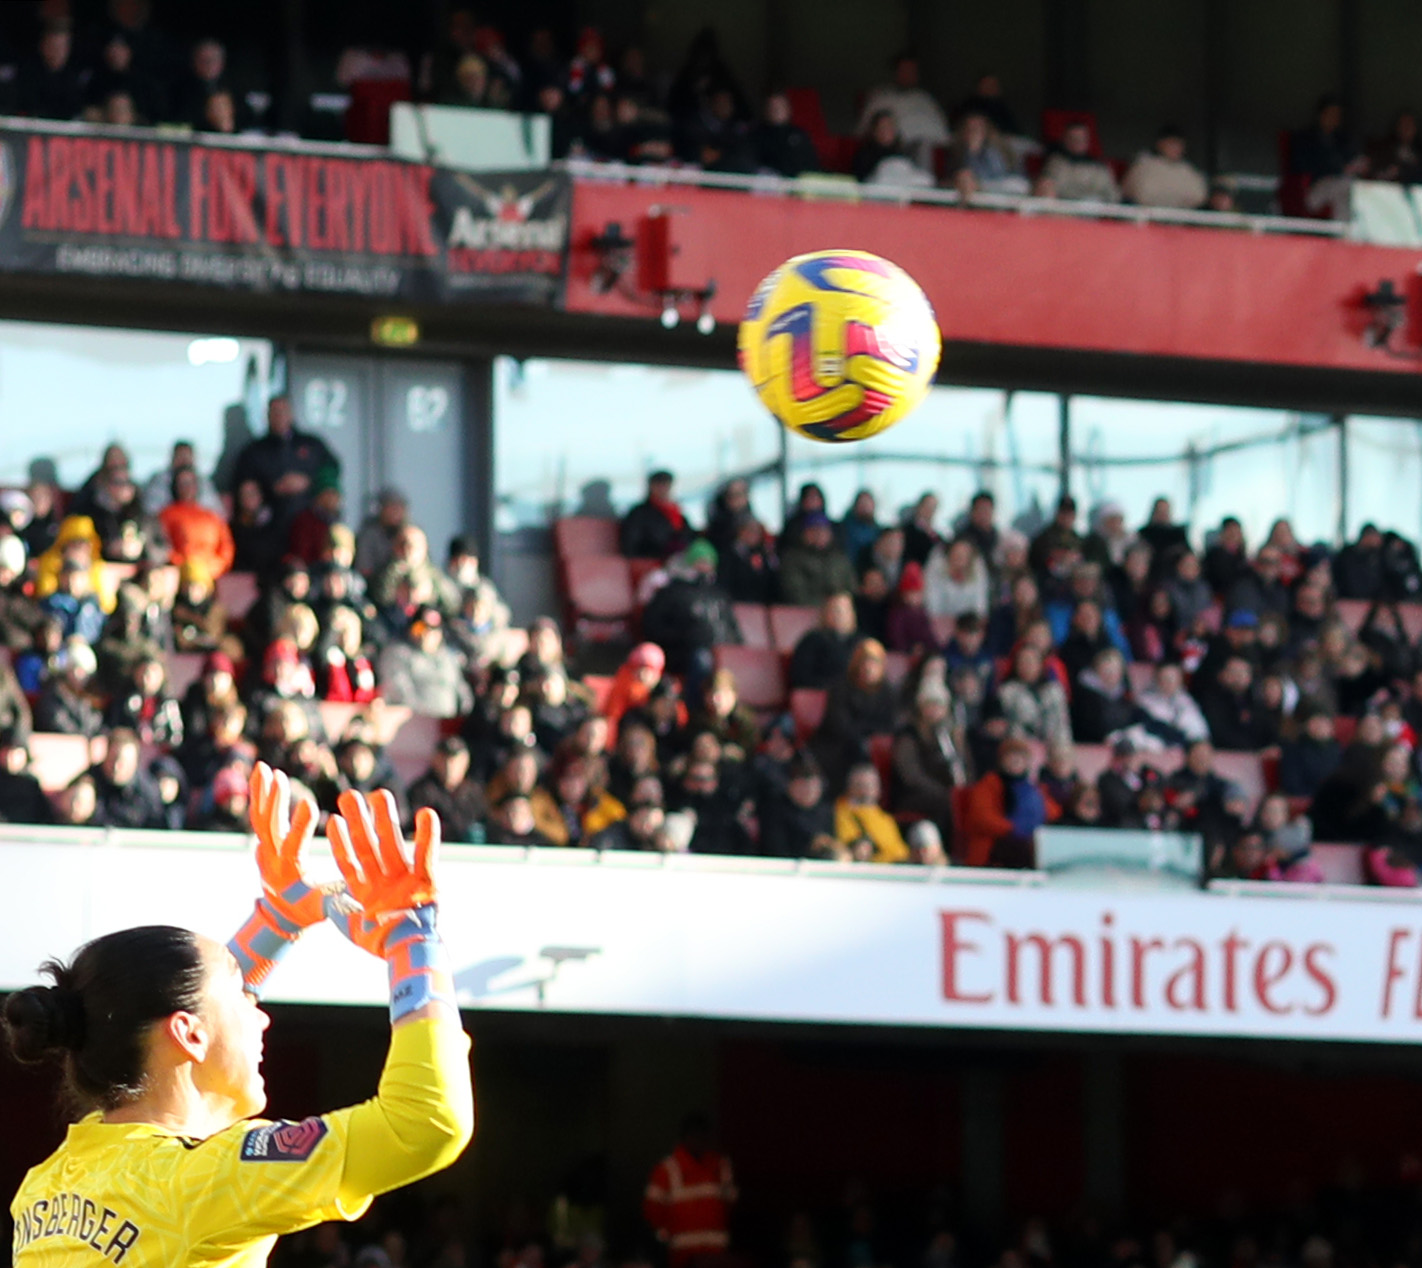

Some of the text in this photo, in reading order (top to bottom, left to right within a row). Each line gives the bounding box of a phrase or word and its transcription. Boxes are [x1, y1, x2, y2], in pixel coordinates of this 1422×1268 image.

[21, 135, 181, 239] ARSENAL
[263, 154, 438, 256] EVERYONE
[938, 910, 1338, 1017] Emirates
